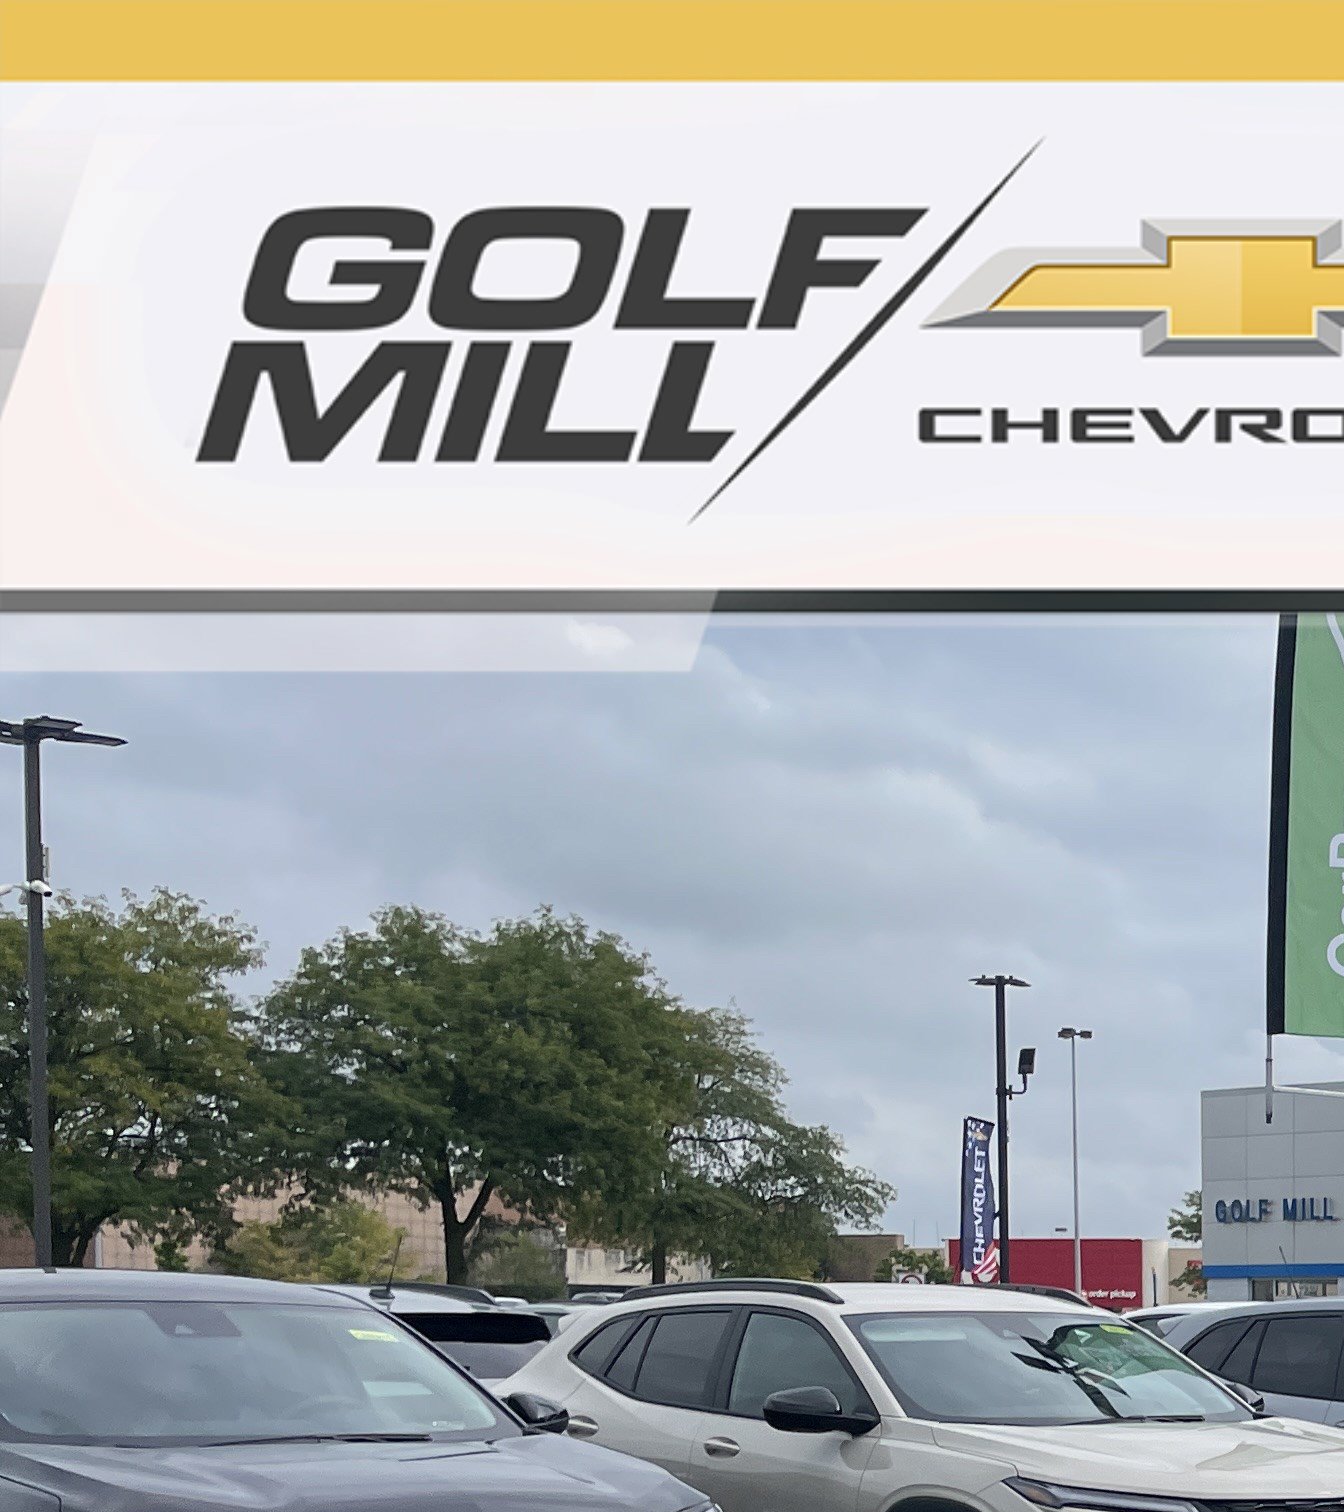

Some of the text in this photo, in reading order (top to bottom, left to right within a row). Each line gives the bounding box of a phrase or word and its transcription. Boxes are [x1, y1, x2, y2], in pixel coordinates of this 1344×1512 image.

[972, 1145, 986, 1265] CHEVROLET
[1215, 1197, 1334, 1223] GOLF MILL
[1088, 1289, 1136, 1300] order pickup
